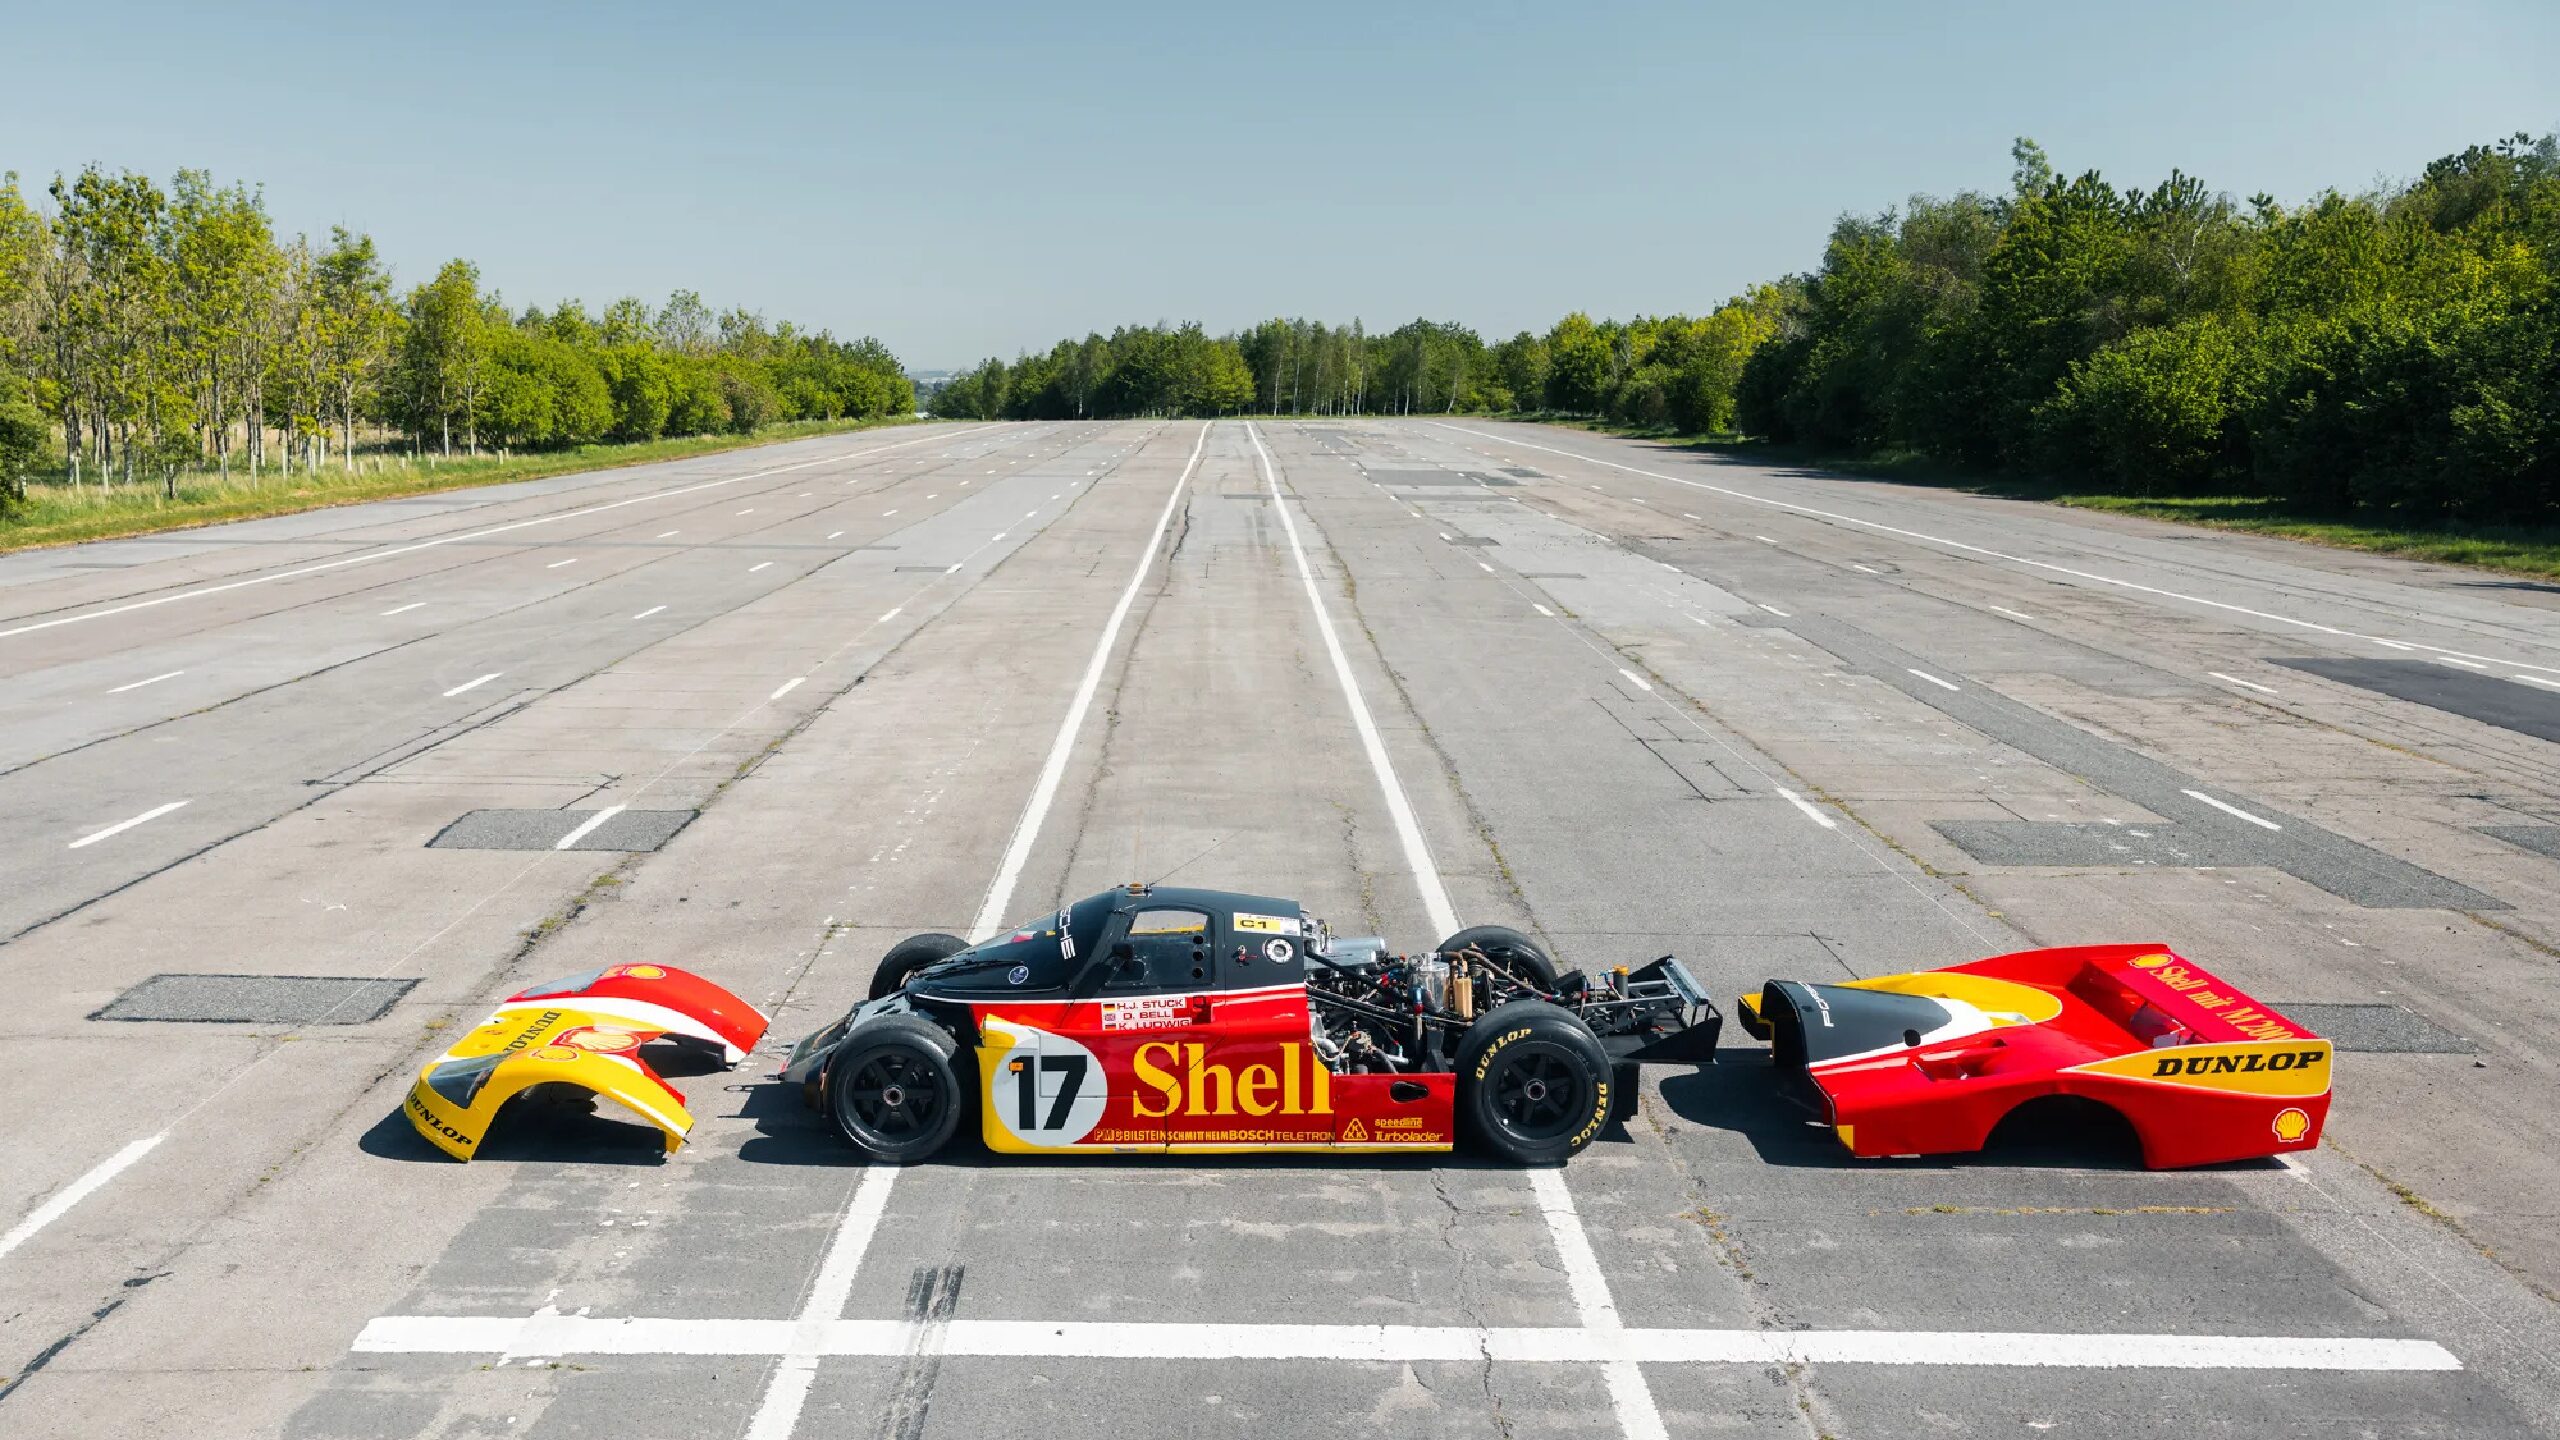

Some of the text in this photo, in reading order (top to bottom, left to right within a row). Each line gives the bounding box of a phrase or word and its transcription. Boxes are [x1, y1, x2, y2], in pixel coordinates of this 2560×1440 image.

[1240, 919, 1267, 929] C1
[2149, 965, 2209, 991] Shell
[2186, 990, 2236, 1009] mit
[1142, 998, 1184, 1009] STUCK
[1119, 1019, 1190, 1030] K. LUDWIG
[1124, 1011, 1171, 1020] D. BELL
[1475, 1028, 1532, 1081] DUNLOP
[2152, 1051, 2324, 1077] DUNLOP
[1132, 1042, 1334, 1118] Shell
[1011, 1054, 1088, 1131] 17
[410, 1093, 473, 1146] DUNLOP
[1123, 1129, 1166, 1140] BILSTEIN
[1229, 1129, 1275, 1141] BOSCH
[1275, 1131, 1335, 1141] TELETRON
[1375, 1131, 1443, 1142] Turbolader
